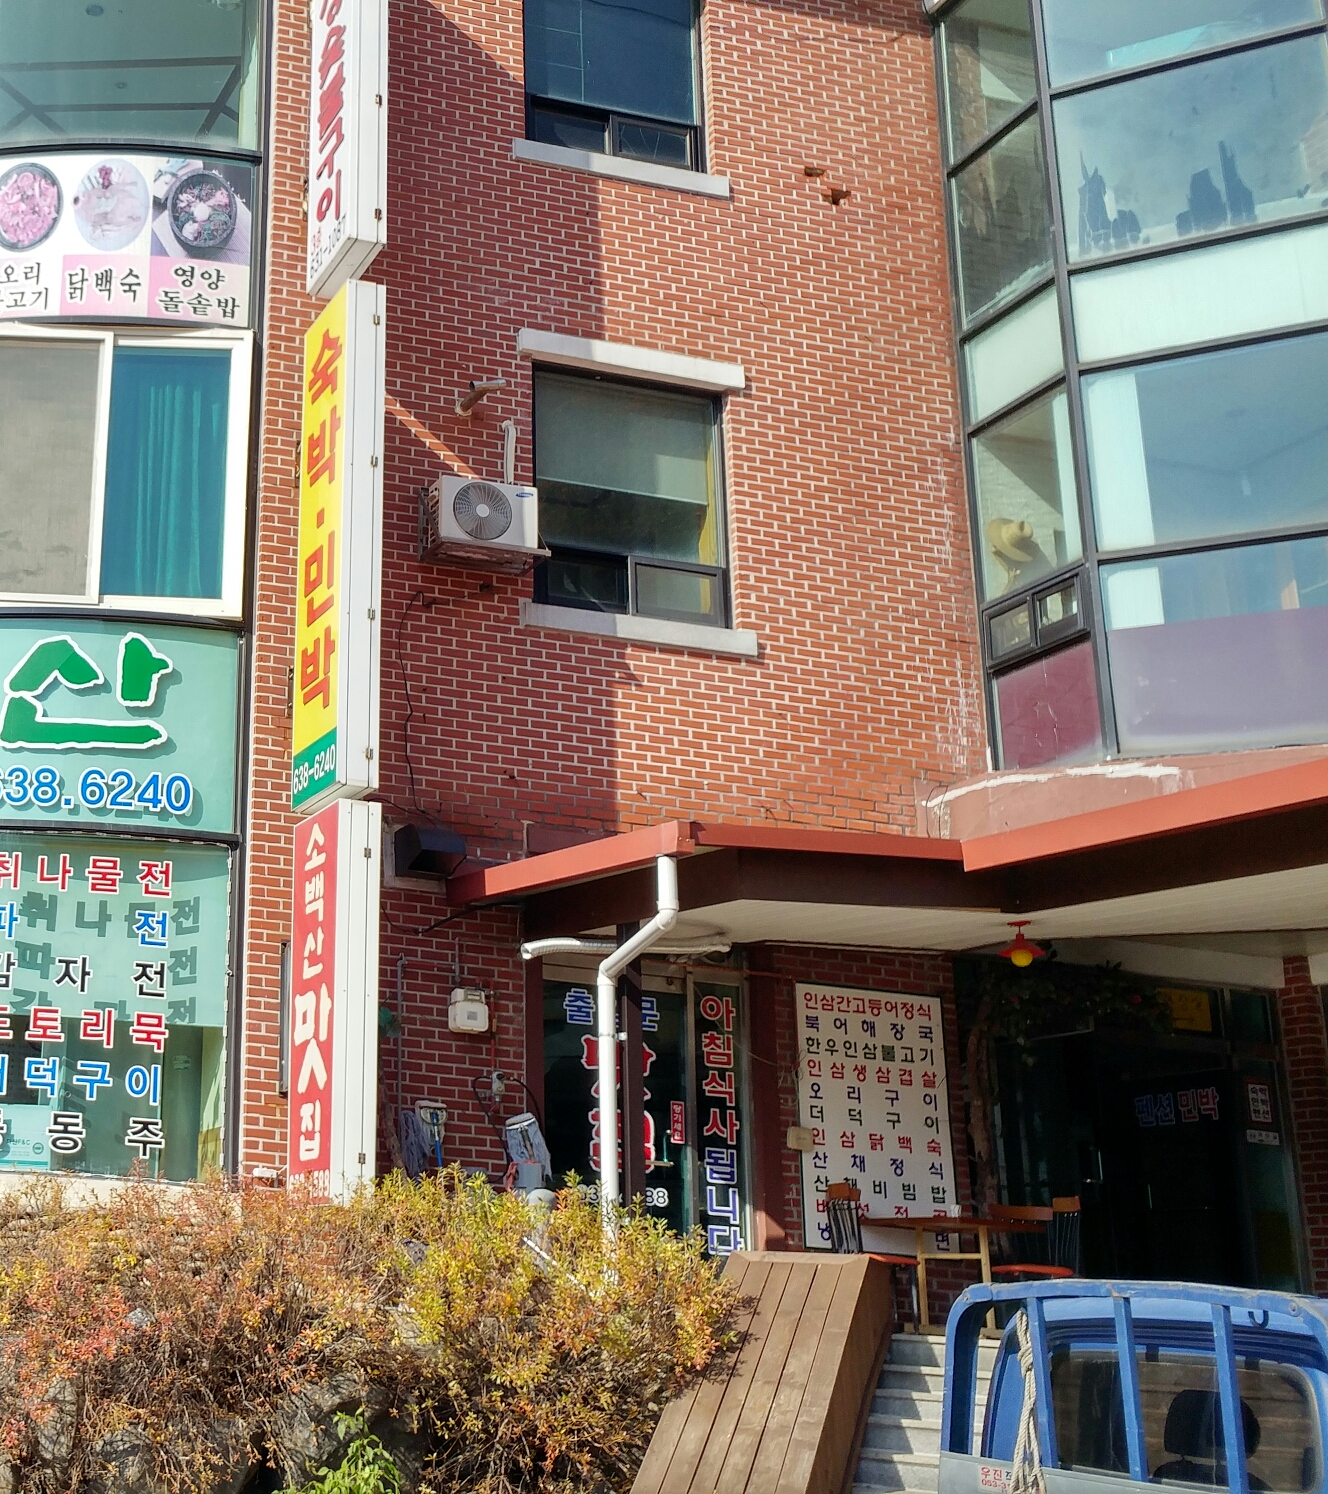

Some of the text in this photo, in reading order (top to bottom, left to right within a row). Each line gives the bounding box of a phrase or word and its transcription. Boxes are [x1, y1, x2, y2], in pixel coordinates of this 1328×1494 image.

[0, 262, 41, 286] 오리
[65, 268, 142, 302] 닭백숙
[172, 264, 226, 289] 영양
[158, 289, 241, 320] 돌솥밥
[293, 743, 336, 795] 638-6240
[294, 822, 332, 1161] 소백산 맛집
[803, 991, 932, 1021] 인삼간고등어정식
[806, 1036, 935, 1066] 한우인삼불고기
[700, 994, 739, 1146] 아침식사
[807, 1059, 938, 1088] 인삼생삼겹살
[1177, 1086, 1220, 1122] 민박
